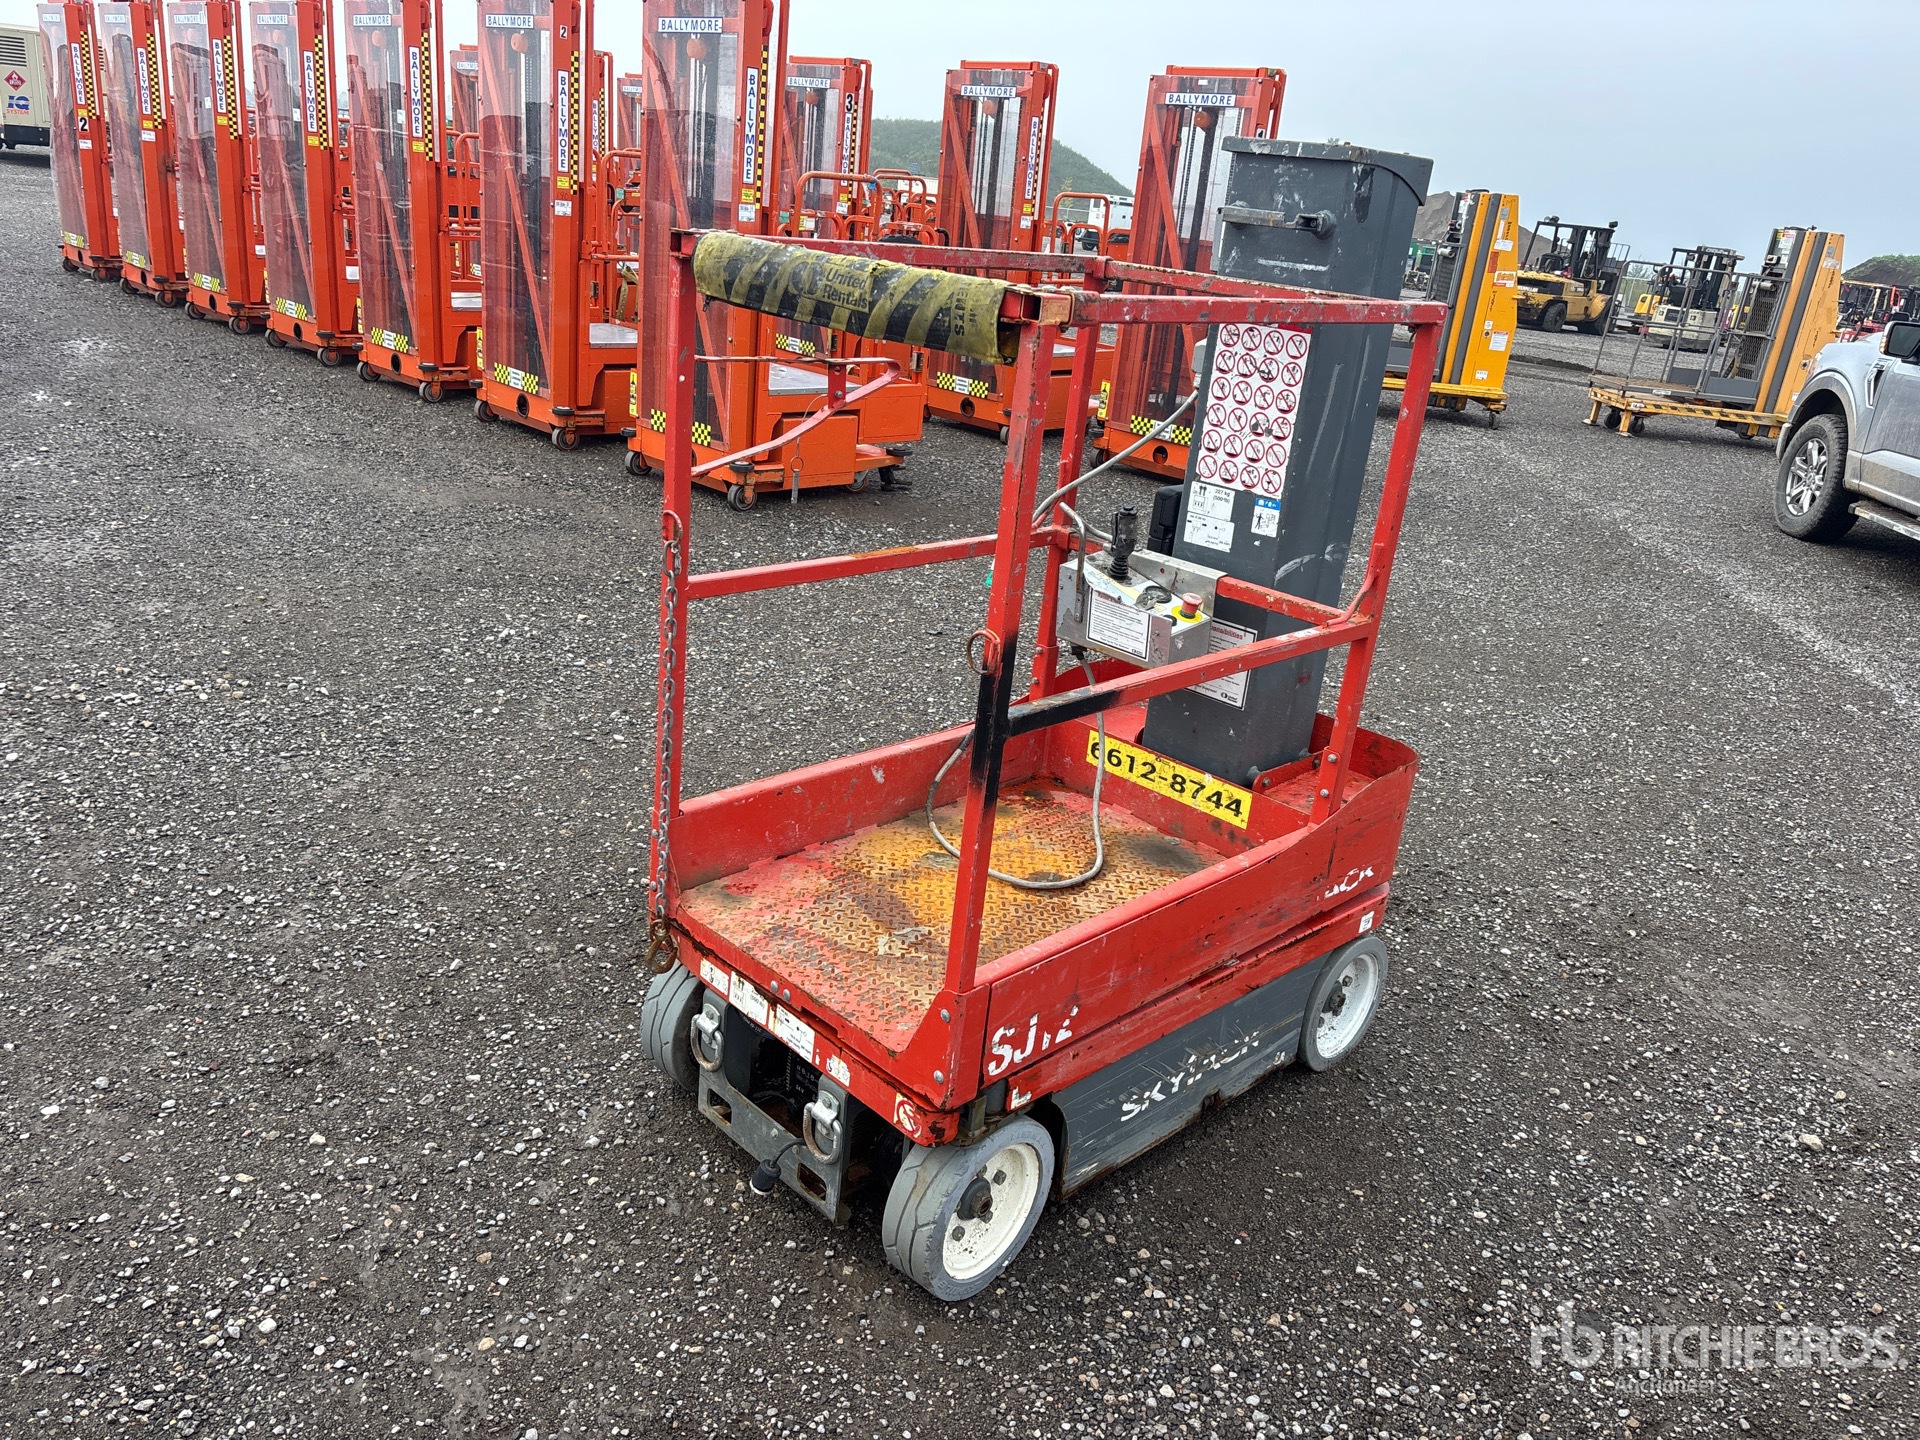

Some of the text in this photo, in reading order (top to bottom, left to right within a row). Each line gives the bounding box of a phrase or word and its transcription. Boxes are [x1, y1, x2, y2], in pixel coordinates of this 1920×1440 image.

[258, 15, 287, 24] BALLYMORE
[355, 16, 389, 25] BALLYMORE
[487, 16, 532, 27] BALLYMORE
[661, 19, 719, 31] BALLYMORE
[560, 27, 566, 38] 2
[73, 46, 83, 103] BALLYMORE
[139, 51, 149, 112] BALLYMORE
[214, 42, 224, 110] BALLYMORE
[789, 77, 828, 87] BALLYMORE
[305, 55, 315, 130] BALLYMORE
[411, 52, 421, 134] BALLYMORE
[963, 86, 1014, 96] BALLYMORE
[1168, 94, 1232, 105] BALLYMORE
[7, 95, 30, 110] IQ
[846, 94, 853, 112] 3
[80, 117, 88, 131] 2
[559, 76, 568, 169] BALLYMORE
[745, 74, 756, 180] BALLYMORE
[1026, 121, 1037, 197] BALLYMORE
[826, 268, 868, 290] United
[823, 284, 868, 309] Rentals
[1211, 625, 1243, 640] onsibilities
[1090, 741, 1242, 817] 6612-8744
